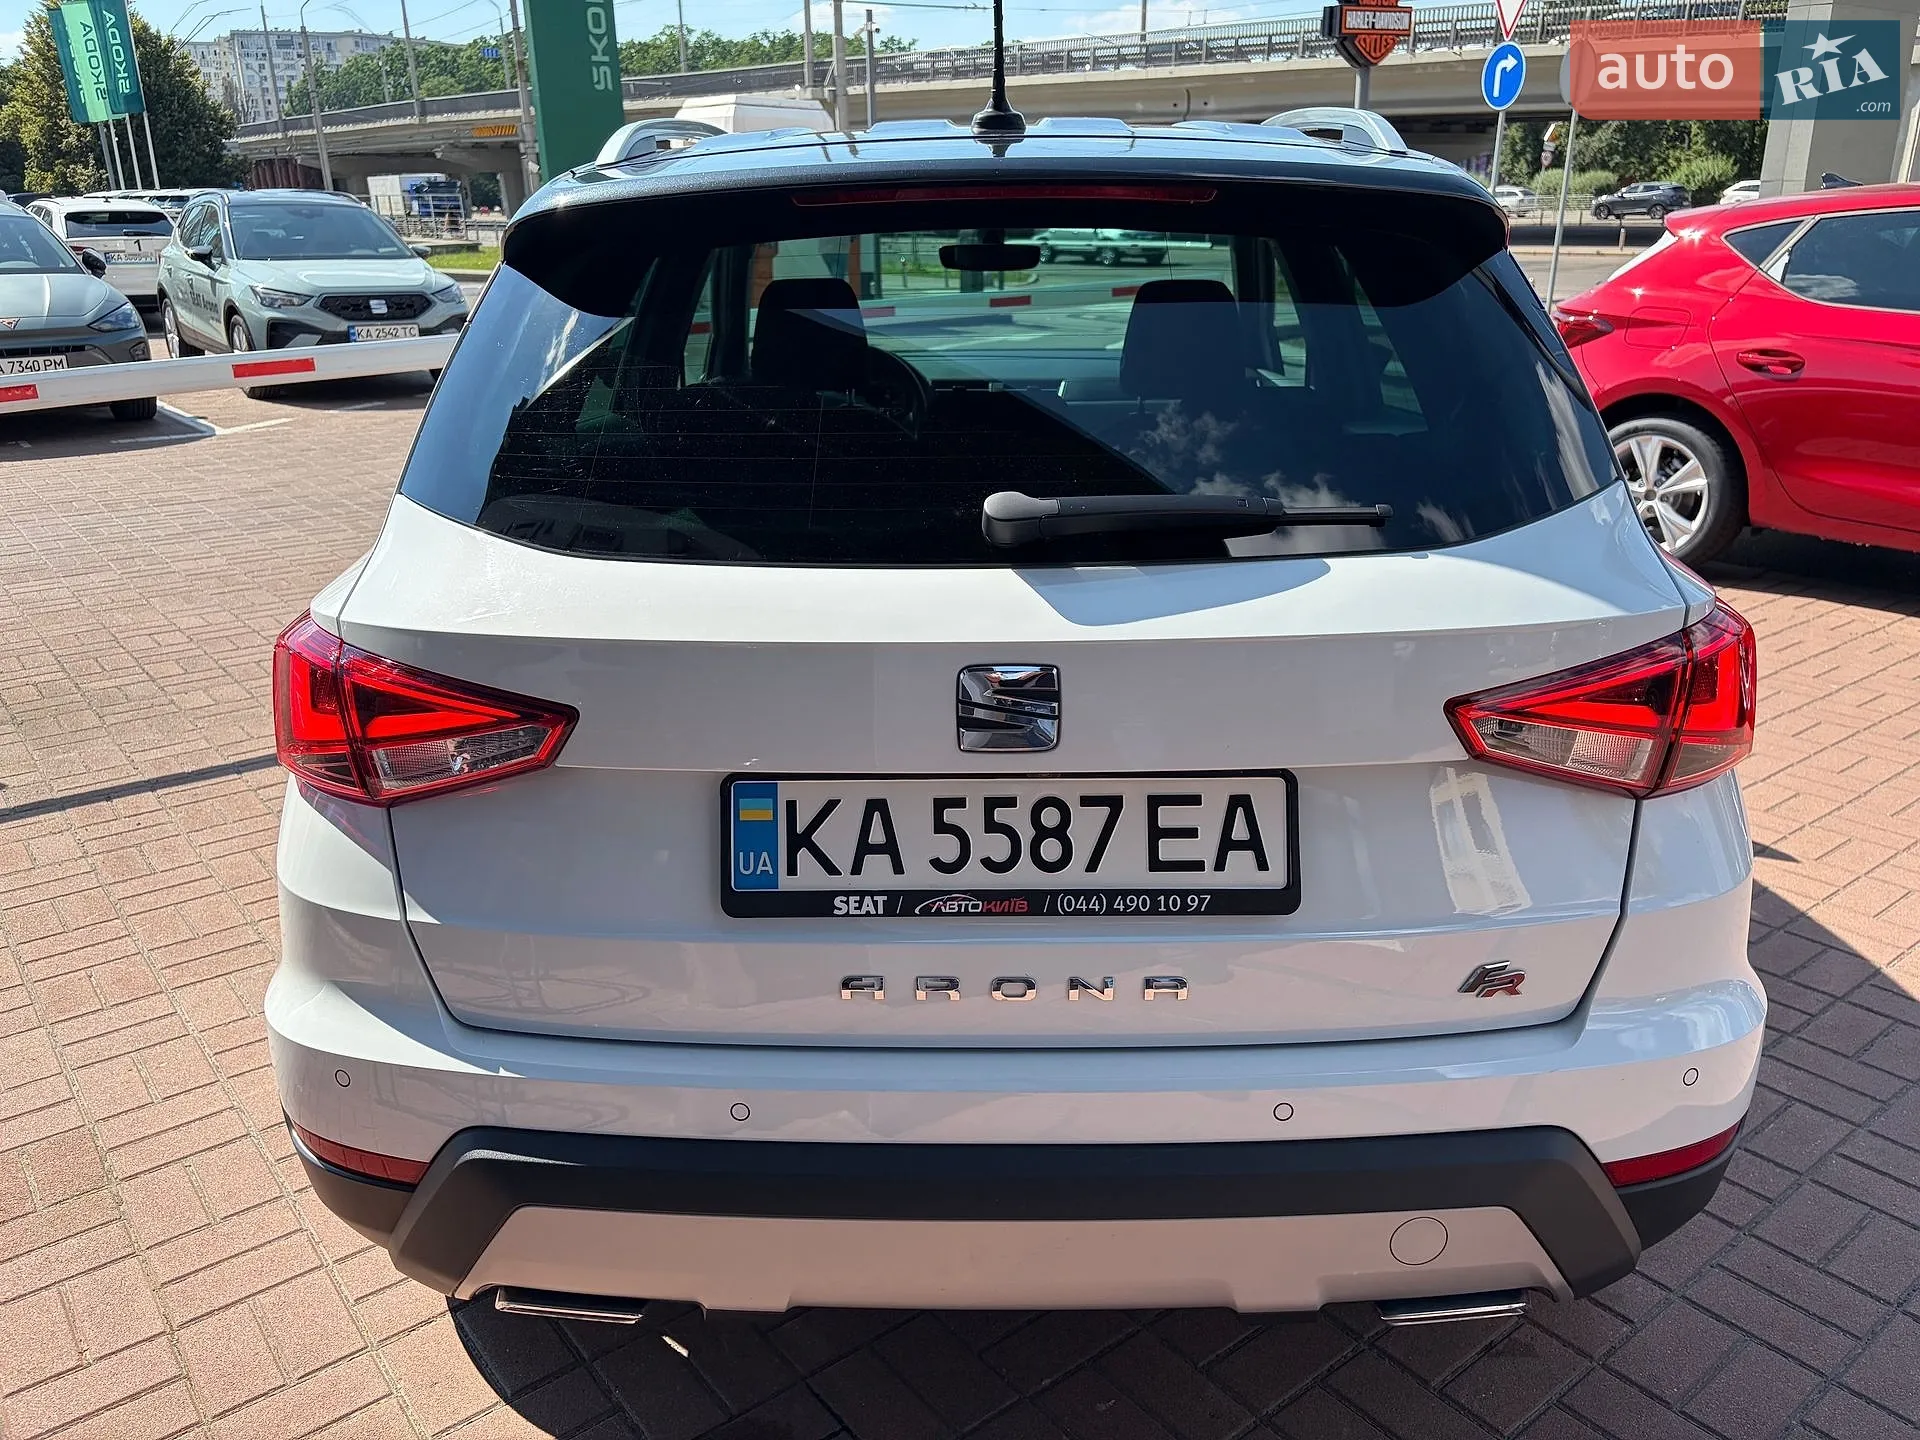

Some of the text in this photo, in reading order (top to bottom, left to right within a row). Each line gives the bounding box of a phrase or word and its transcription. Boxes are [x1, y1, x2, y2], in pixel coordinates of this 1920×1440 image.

[134, 240, 142, 252] 1
[357, 328, 373, 339] KA
[376, 327, 399, 339] 2542
[401, 326, 417, 338] TC
[7, 359, 41, 374] 7340
[43, 357, 65, 371] PM
[785, 793, 1270, 877] KA 5587 EA
[739, 851, 774, 875] UA
[832, 895, 888, 915] SEAT
[1056, 893, 1107, 915] (044)
[1113, 895, 1150, 912] 490
[1157, 895, 1181, 912] 10
[1187, 895, 1211, 912] 97
[840, 975, 1189, 1001] ARONA
